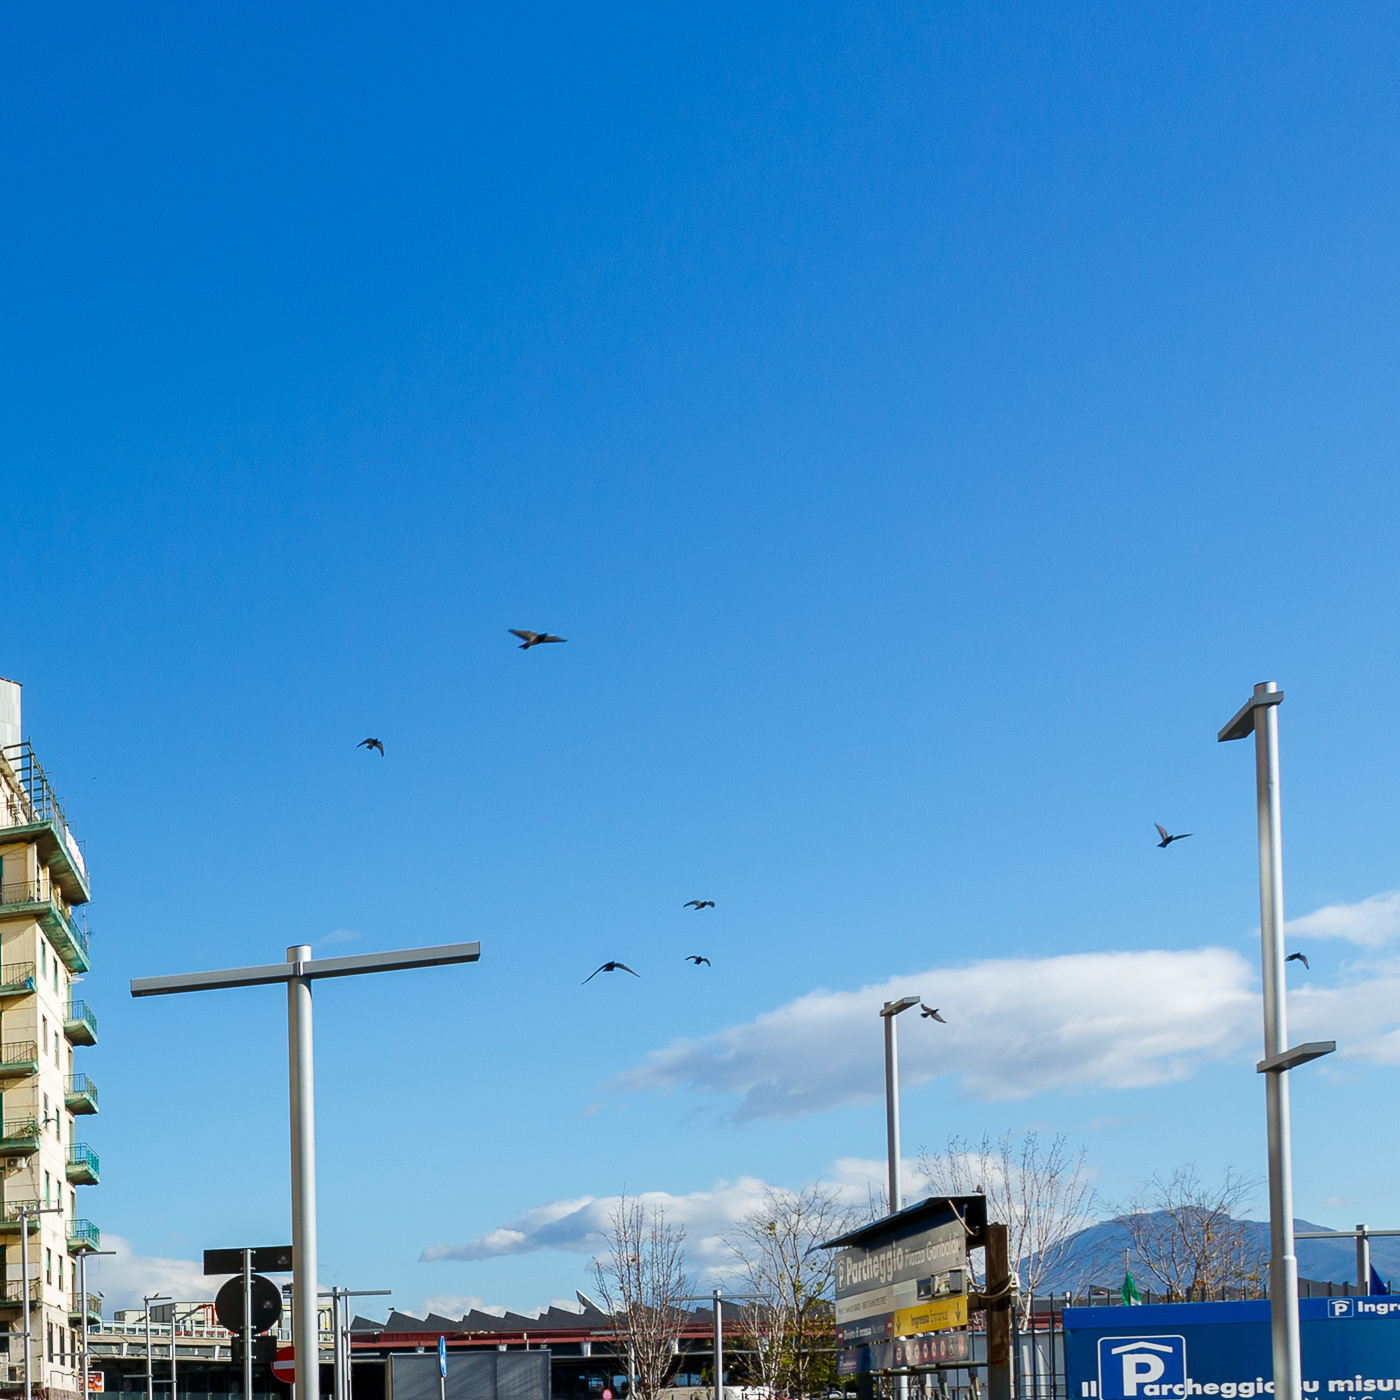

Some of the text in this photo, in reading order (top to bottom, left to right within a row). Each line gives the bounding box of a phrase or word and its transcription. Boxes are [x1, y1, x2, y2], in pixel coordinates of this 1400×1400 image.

[846, 1241, 904, 1285] Parcheggio
[904, 1248, 925, 1267] Piazza
[926, 1232, 960, 1261] Garibaldi
[1081, 1381, 1097, 1397] Il
[1122, 1353, 1275, 1399] Parcheggio
